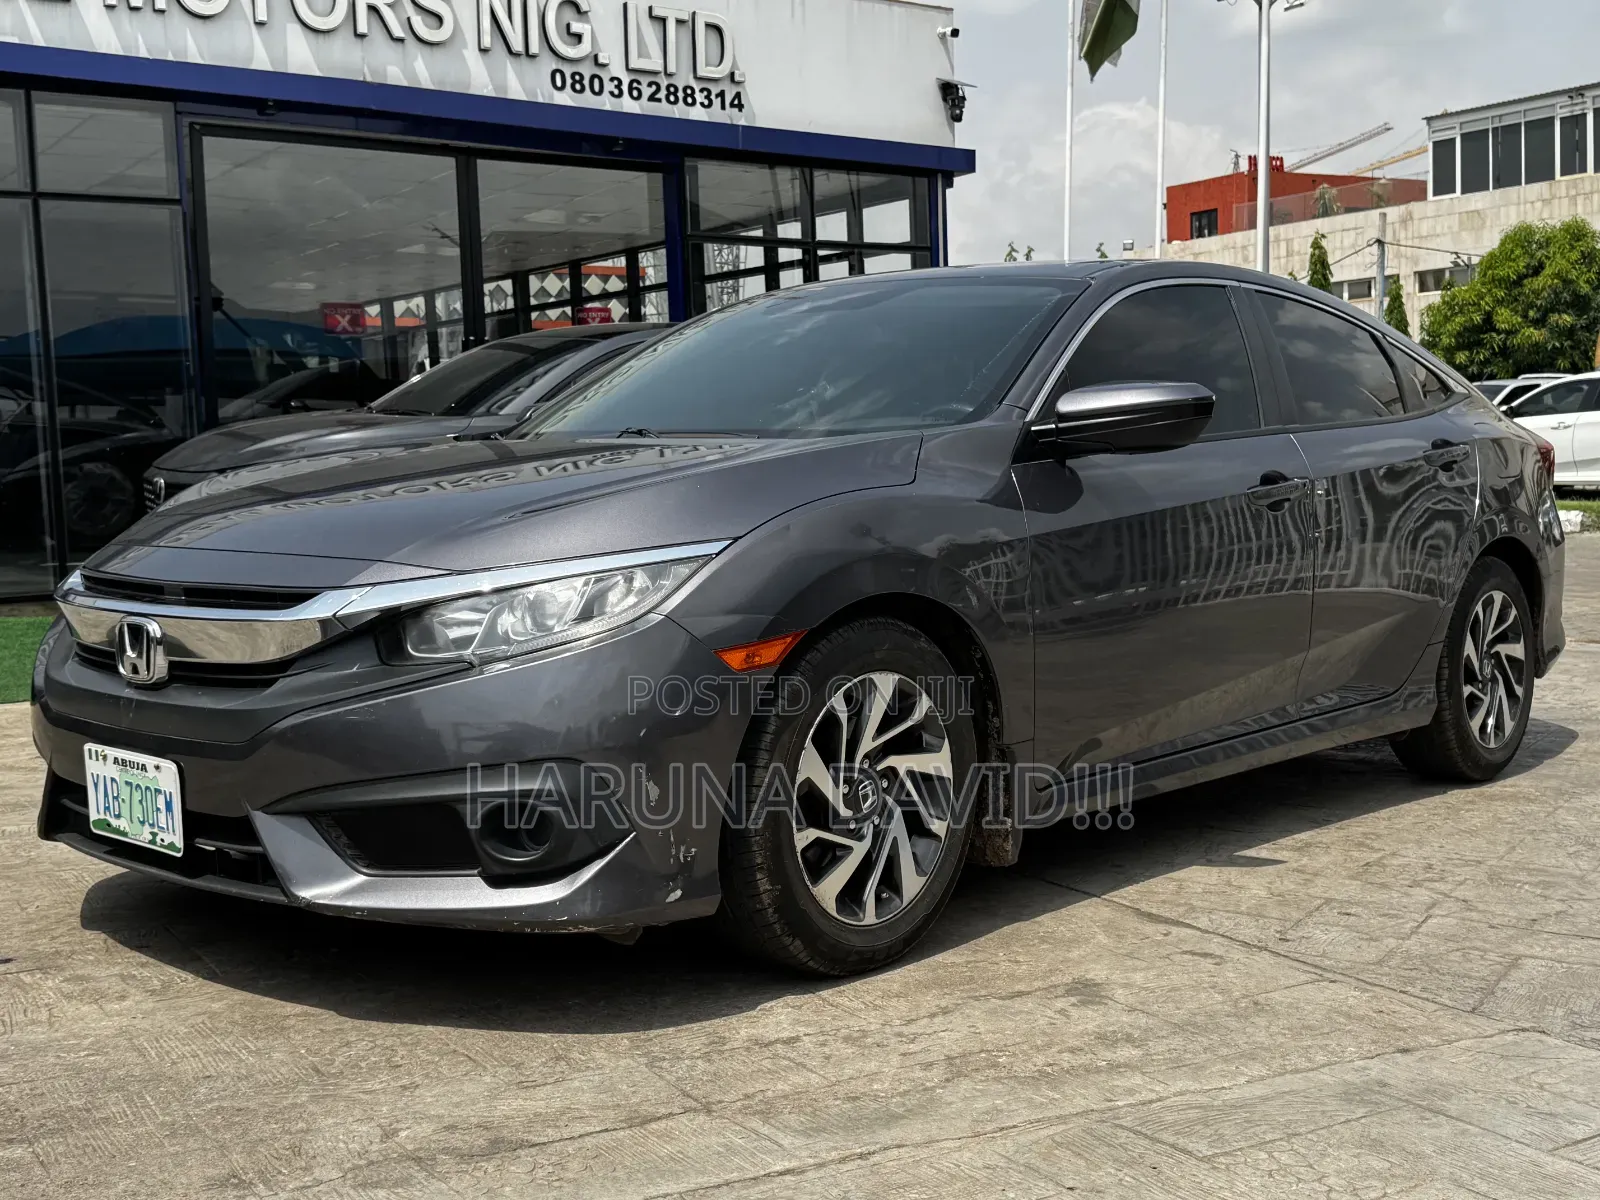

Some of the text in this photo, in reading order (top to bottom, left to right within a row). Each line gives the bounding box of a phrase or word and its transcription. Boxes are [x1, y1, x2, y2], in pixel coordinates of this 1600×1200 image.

[478, 0, 609, 66] NIG.
[624, 1, 745, 83] LTD.
[550, 68, 745, 112] 08036288314
[112, 756, 148, 773] ABUJA
